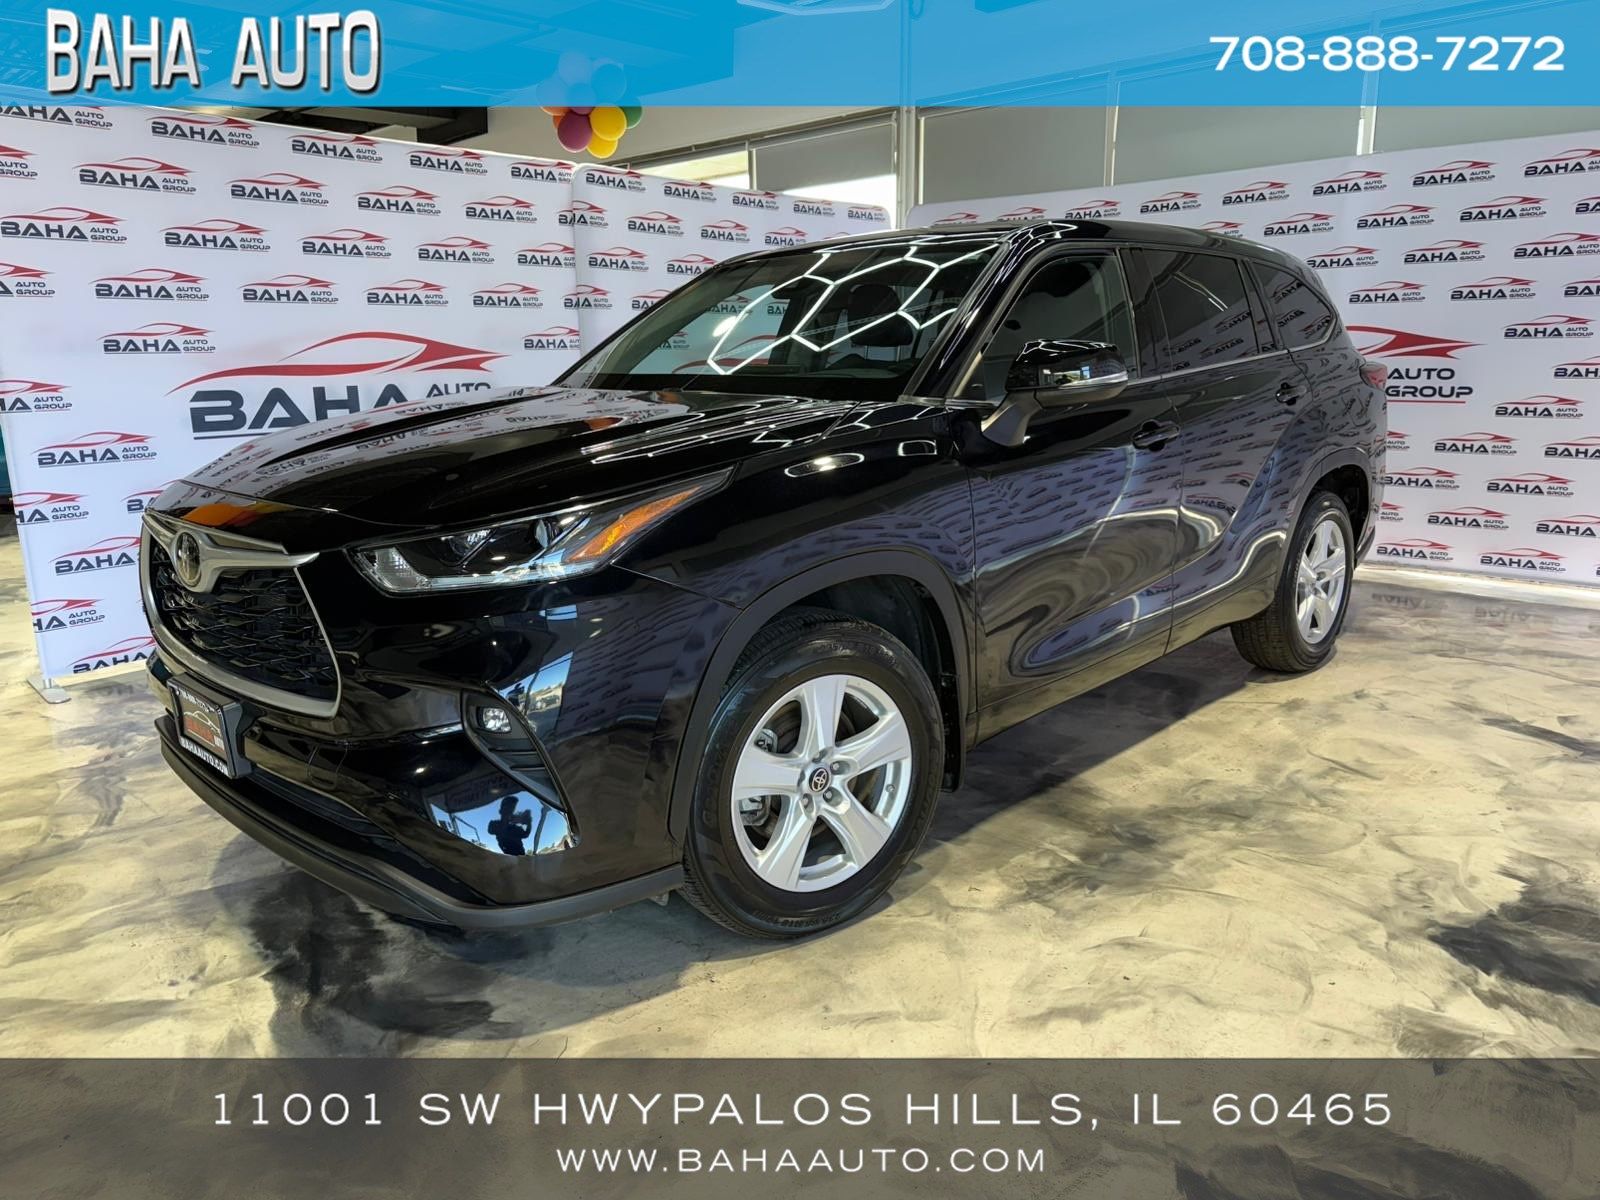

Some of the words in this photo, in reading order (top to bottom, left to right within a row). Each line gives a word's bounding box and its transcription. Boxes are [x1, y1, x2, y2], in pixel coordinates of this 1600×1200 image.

[0, 105, 73, 123] AHA
[74, 110, 104, 120] AUTO
[74, 117, 113, 128] GROUP
[151, 121, 227, 144] BAHA
[227, 131, 253, 139] AUTO
[228, 138, 259, 146] GROUP
[291, 139, 355, 159] BAHA
[409, 154, 464, 172] BAHA
[1524, 161, 1585, 177] BAHA
[78, 168, 161, 189] BAHA
[510, 166, 557, 182] BAHA
[1412, 172, 1468, 187] BAHA
[162, 177, 189, 185] AUTO
[586, 172, 626, 190] BAHA
[162, 185, 196, 193] GROUP
[230, 184, 299, 202] BAHA
[300, 190, 323, 198] AUTO
[664, 185, 700, 200] BAHA
[1313, 181, 1362, 196] BAHA
[732, 195, 764, 209] BAHA
[1222, 191, 1266, 205] BAHA
[357, 197, 416, 213] BAHA
[793, 203, 822, 216] BAHA
[1140, 203, 1180, 214] BAHA
[465, 207, 515, 220] BAHA
[847, 209, 874, 221] BAHA
[1459, 208, 1517, 221] BAHA
[628, 219, 666, 234] BAHA
[1356, 216, 1408, 228] BAHA
[1, 221, 89, 240] BAHA
[90, 226, 119, 234] AUTO
[700, 227, 734, 241] BAHA
[1264, 224, 1310, 236] BAHA
[90, 234, 127, 242] GROUP
[164, 232, 238, 249] BAHA
[239, 236, 264, 244] AUTO
[764, 234, 795, 247] BAHA
[302, 241, 364, 256] BAHA
[418, 248, 471, 262] BAHA
[1513, 245, 1575, 258] BAHA
[517, 254, 563, 266] BAHA
[588, 256, 630, 270] BAHA
[1307, 257, 1354, 268] BAHA
[1404, 252, 1458, 263] BAHA
[666, 263, 702, 275] BAHA
[15, 288, 55, 296] GROUP
[95, 283, 175, 299] BAHA
[242, 289, 309, 302] BAHA
[1450, 288, 1507, 300] BAHA
[367, 292, 421, 305] BAHA
[472, 295, 521, 307] BAHA
[1349, 293, 1400, 303] BAHA
[1504, 327, 1563, 338] BAHA
[103, 339, 181, 353] BAHA
[524, 339, 568, 349] BAHA
[1387, 368, 1456, 380] AUTO
[1554, 367, 1600, 378] BAH
[1385, 385, 1474, 398] GROUP
[189, 383, 410, 433] BAHA
[1495, 406, 1554, 418] BAHA
[122, 445, 150, 453] AUTO
[1434, 442, 1489, 453] BAHA
[38, 447, 121, 467] BAHA
[122, 451, 157, 460] GROUP
[1487, 482, 1545, 495] BAHA
[51, 504, 81, 513] AUTO
[51, 511, 90, 520] GROUP
[1427, 515, 1481, 528] BAHA
[1536, 523, 1597, 537] BAHA
[1377, 546, 1428, 560] BAHA
[55, 551, 136, 574] BAHA
[1480, 555, 1537, 569] BAHA
[68, 610, 97, 618] AUTO
[69, 615, 105, 626] GROUP
